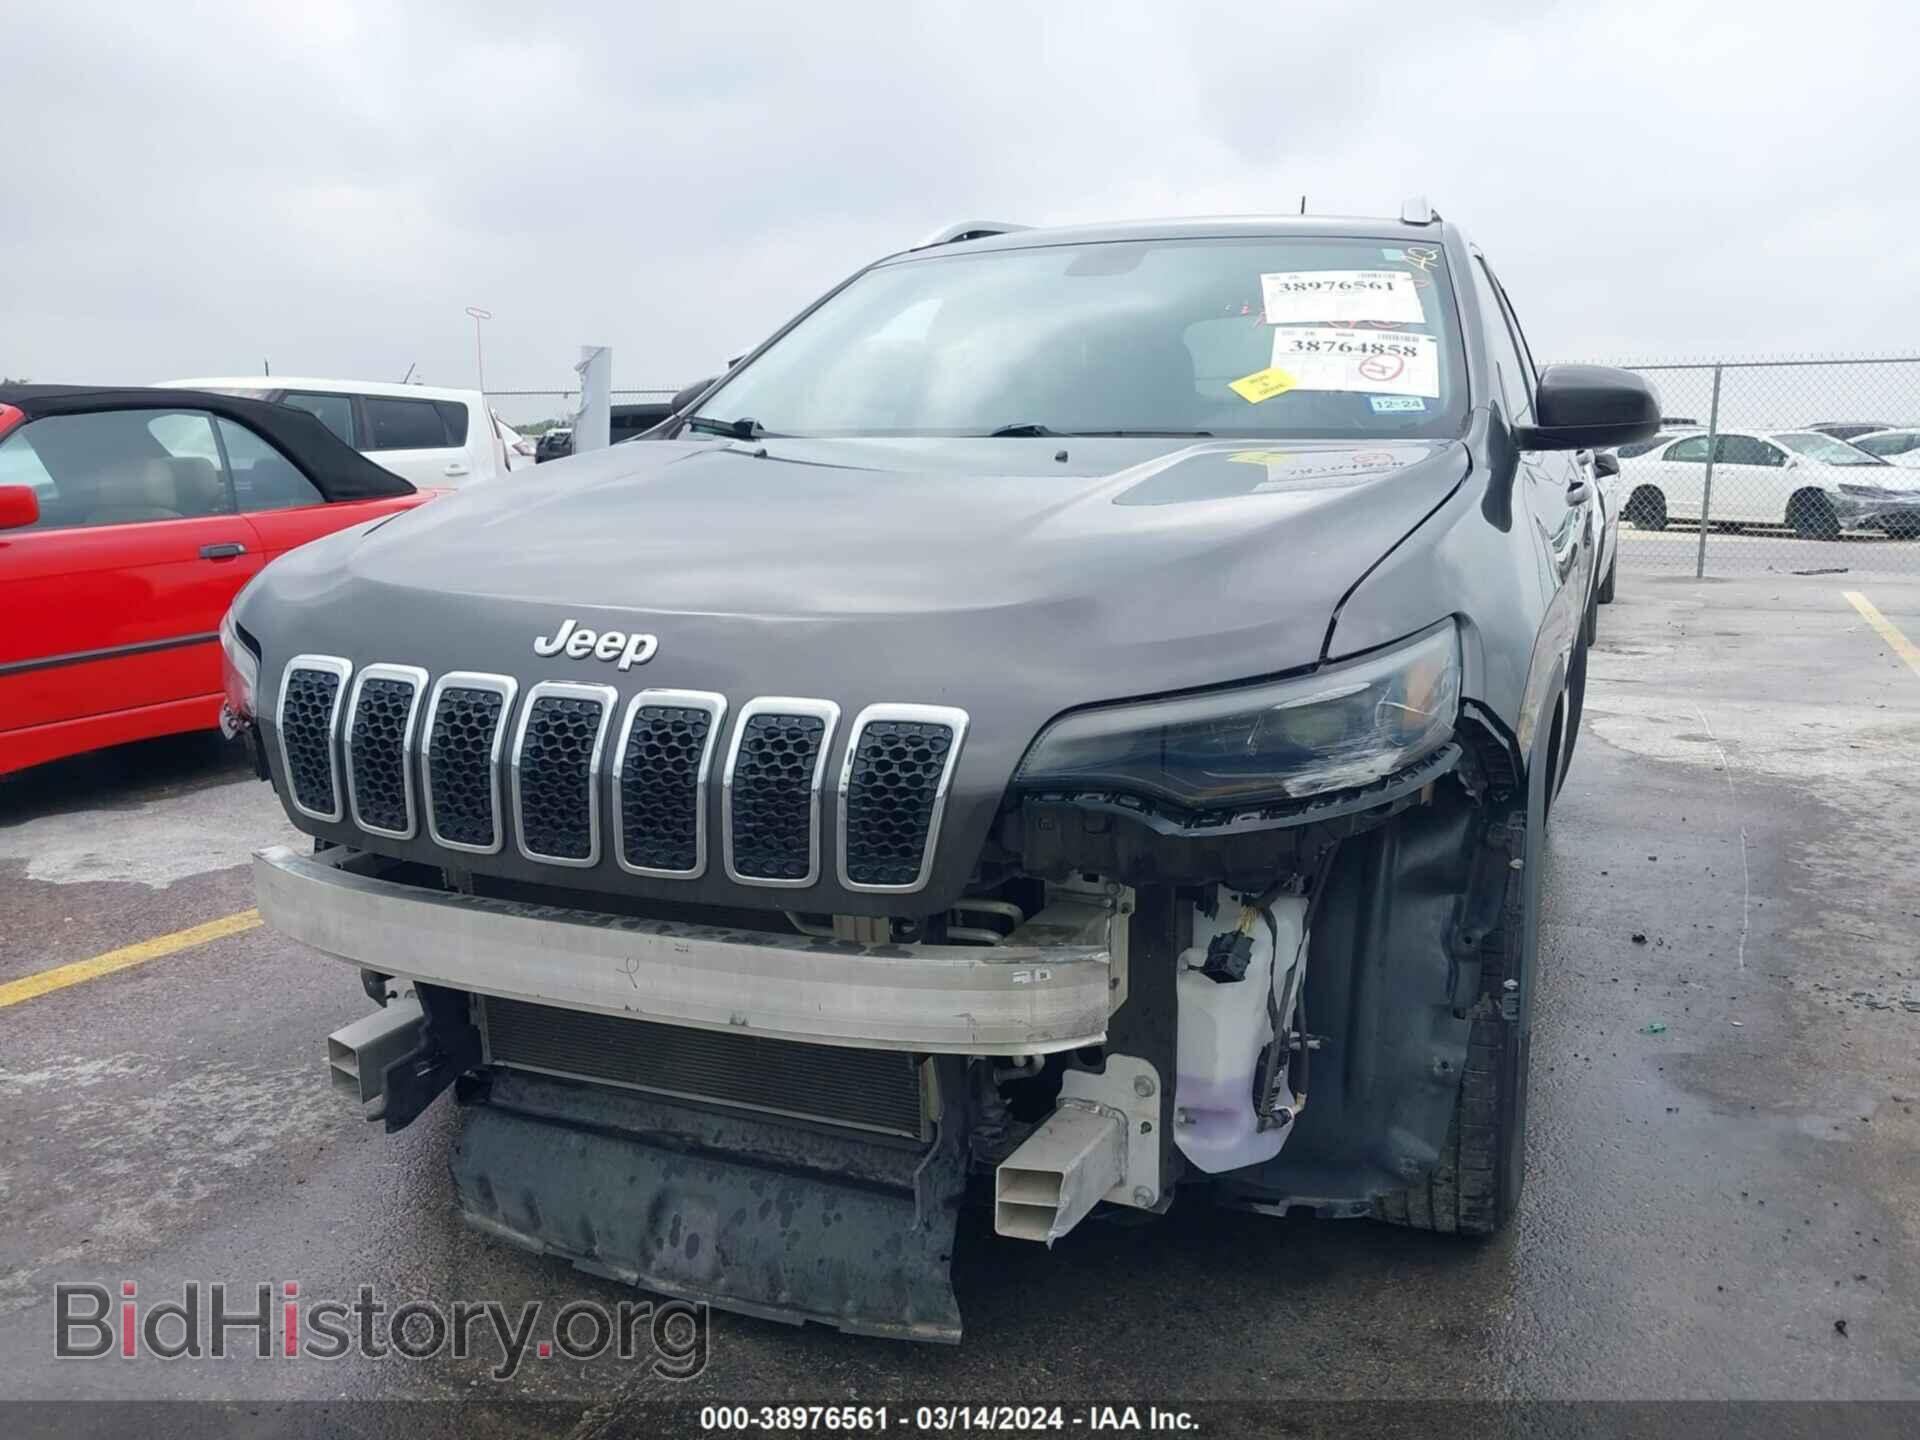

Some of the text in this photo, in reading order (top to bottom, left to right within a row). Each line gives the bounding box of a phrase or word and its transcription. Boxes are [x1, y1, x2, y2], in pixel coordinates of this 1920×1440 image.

[1279, 280, 1394, 292] 38976561
[1289, 340, 1417, 357] 38764858
[533, 619, 658, 672] Jeep
